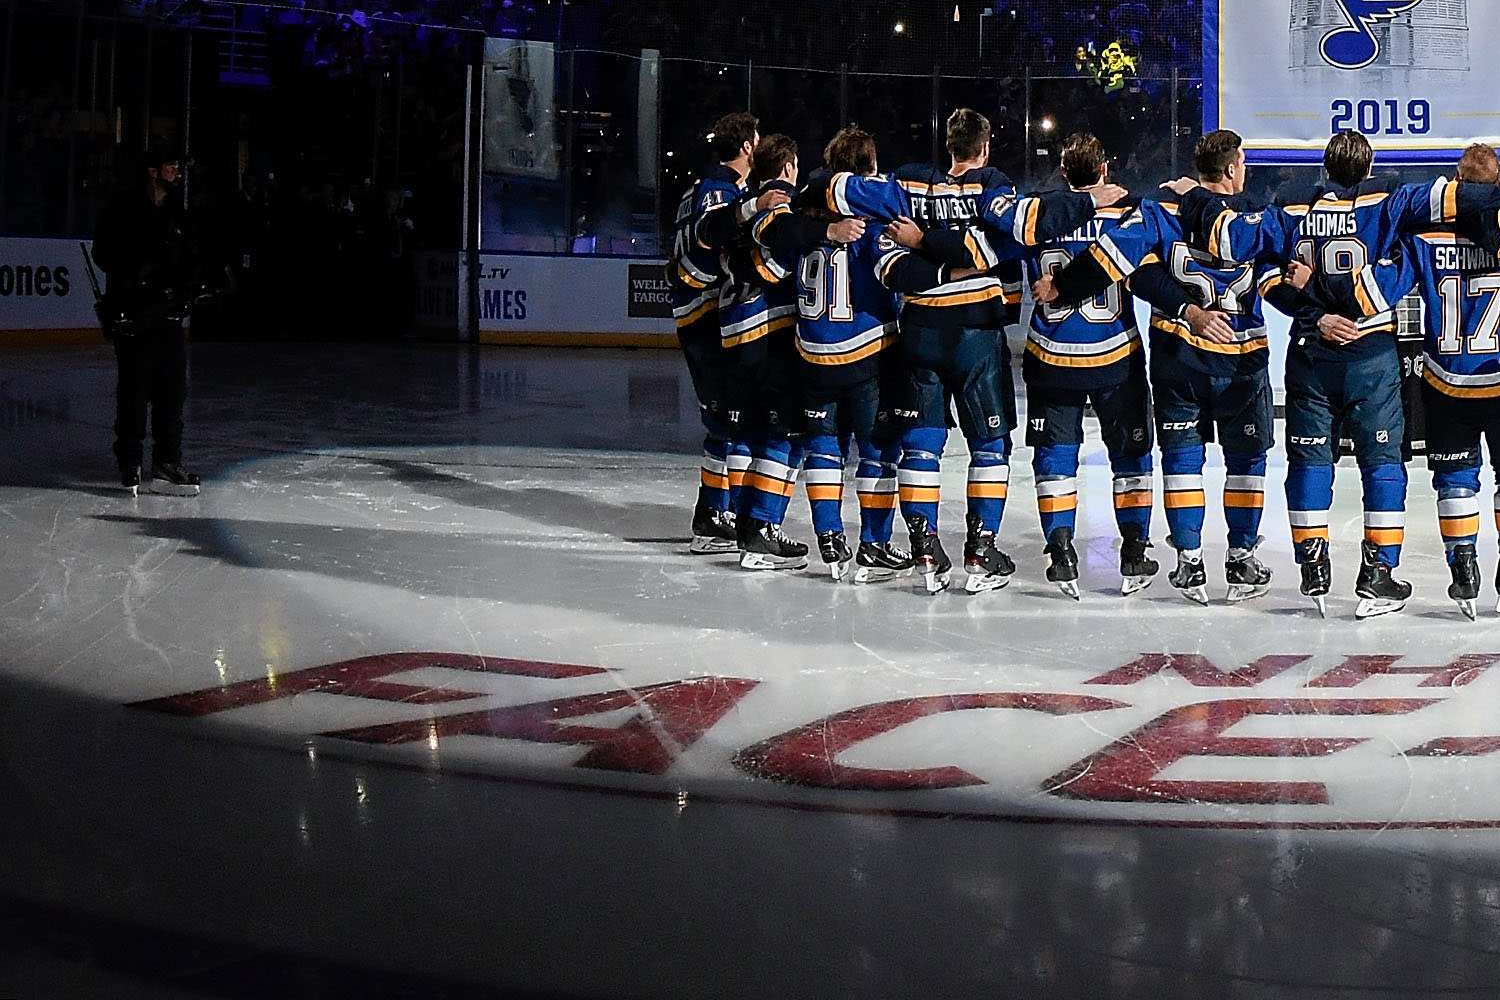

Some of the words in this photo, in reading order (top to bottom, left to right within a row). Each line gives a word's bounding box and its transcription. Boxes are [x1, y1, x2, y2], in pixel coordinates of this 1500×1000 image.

[1330, 98, 1432, 135] 2019
[1299, 211, 1357, 237] THOMAS
[0, 264, 70, 297] ones
[797, 247, 854, 322] 91
[1162, 419, 1200, 431] CCM
[1290, 435, 1328, 446] CCM
